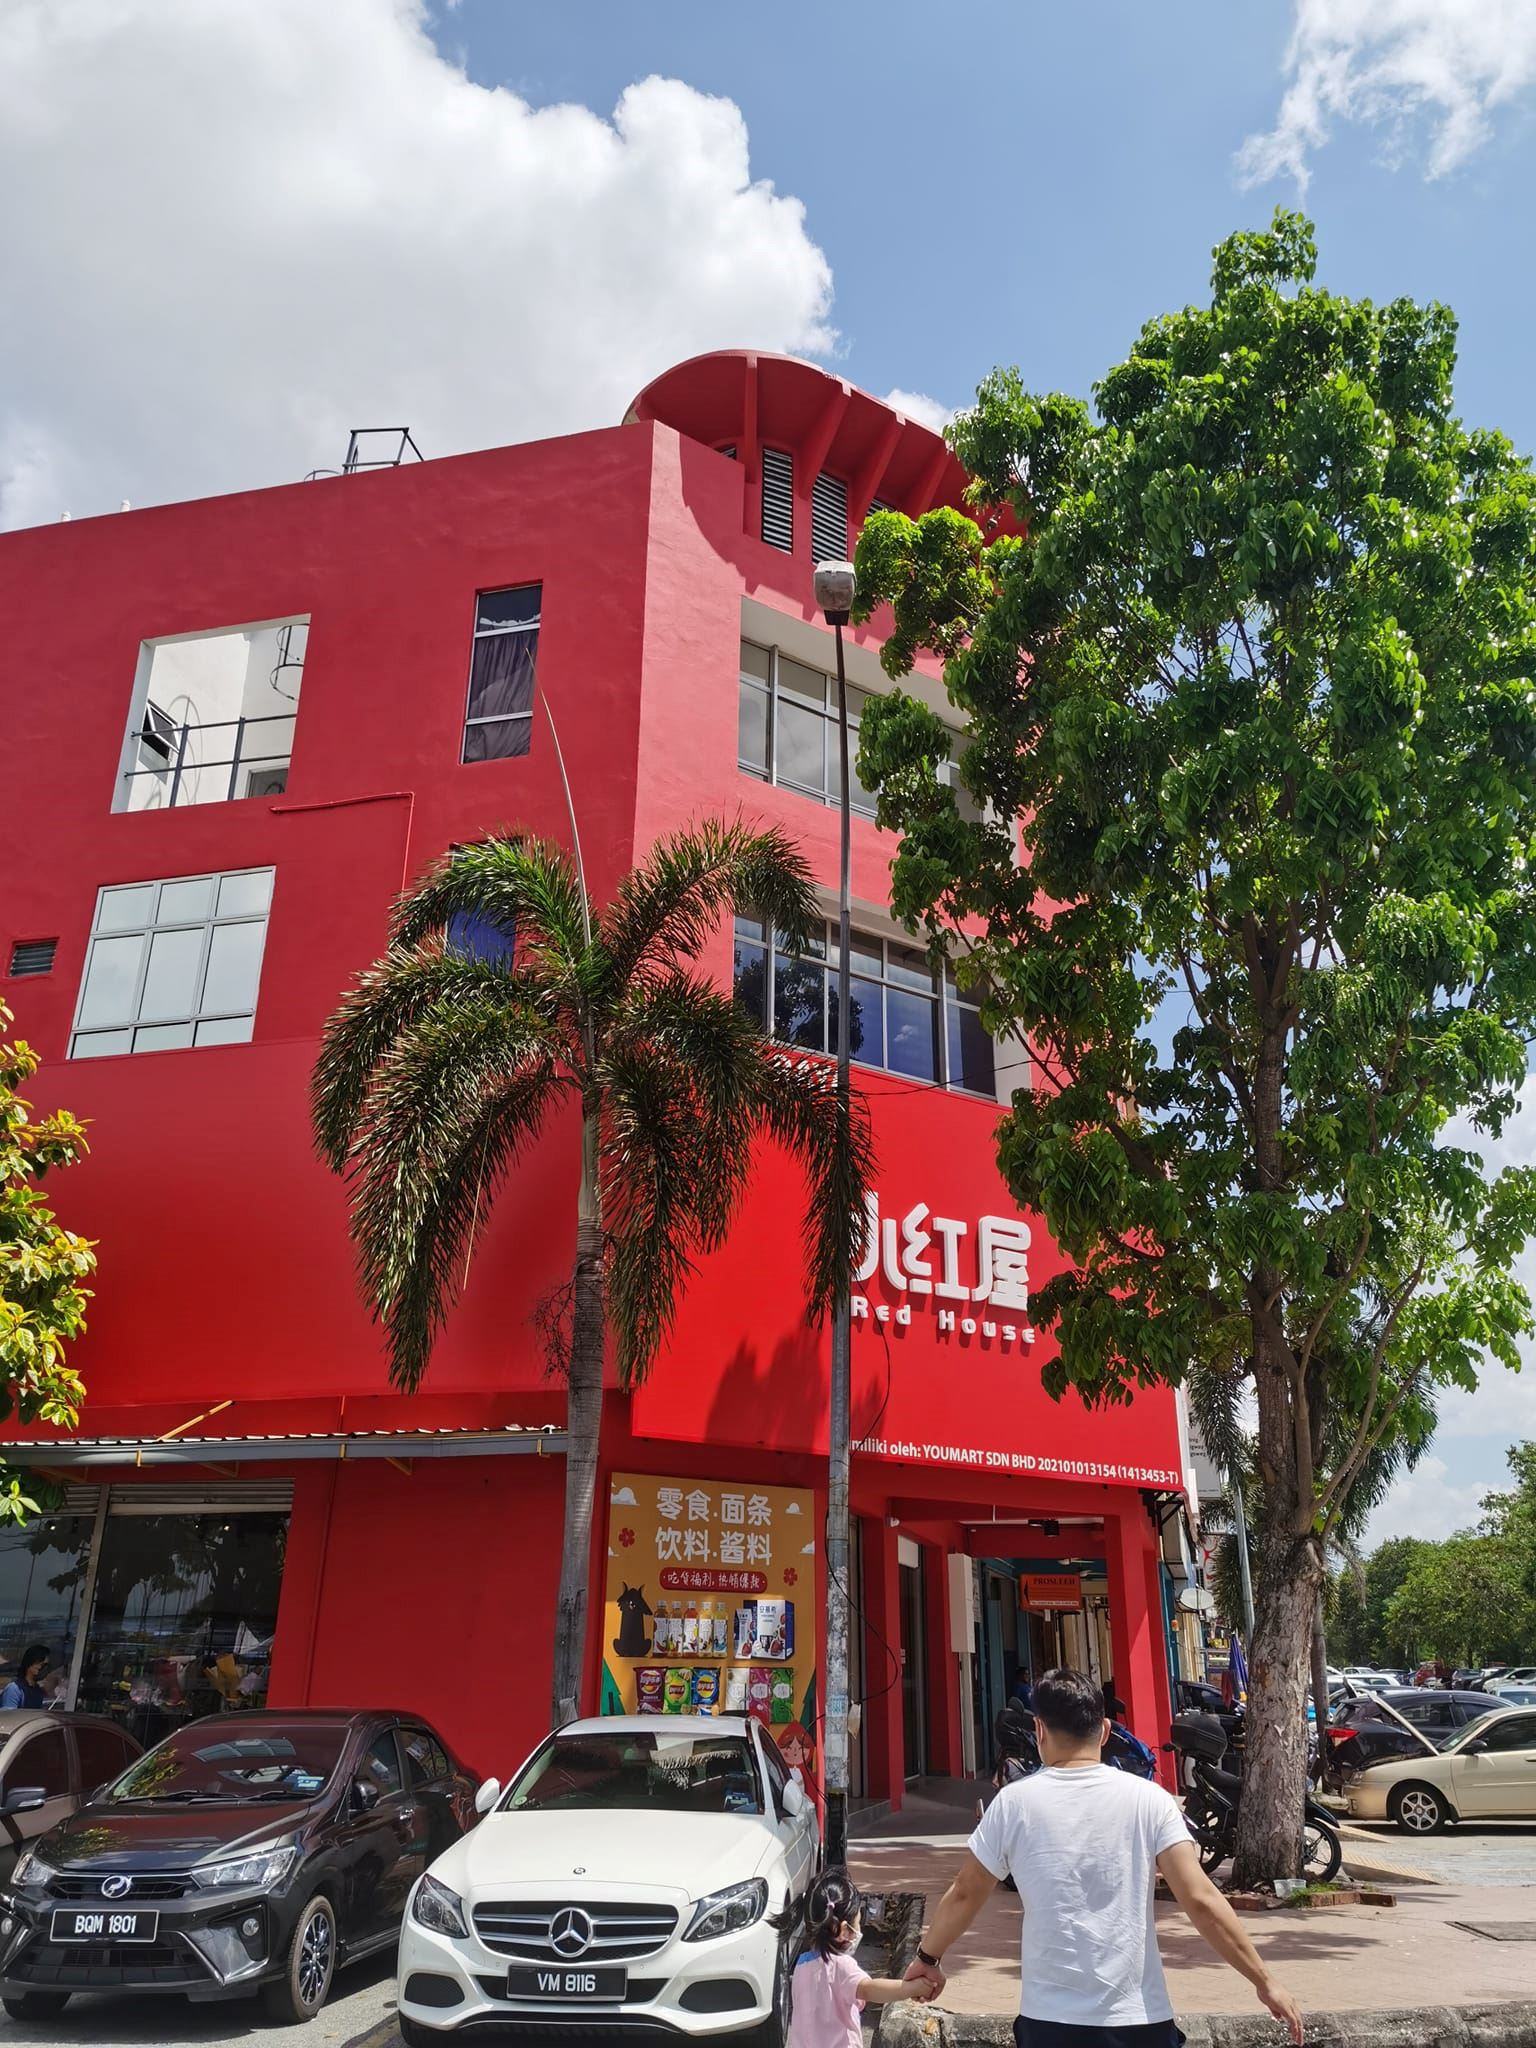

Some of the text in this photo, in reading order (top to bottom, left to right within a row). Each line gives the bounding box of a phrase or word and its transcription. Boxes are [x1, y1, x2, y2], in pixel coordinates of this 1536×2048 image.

[890, 1441, 921, 1458] oleh:
[922, 1444, 985, 1465] YOUMART
[986, 1452, 1009, 1468] SDN
[1011, 1454, 1036, 1469] BHD
[1038, 1457, 1116, 1478] 202101013154
[1117, 1465, 1179, 1485] (1413453-T)
[74, 1914, 137, 1934] BQM 1801
[537, 1973, 597, 1993] VM 8116
